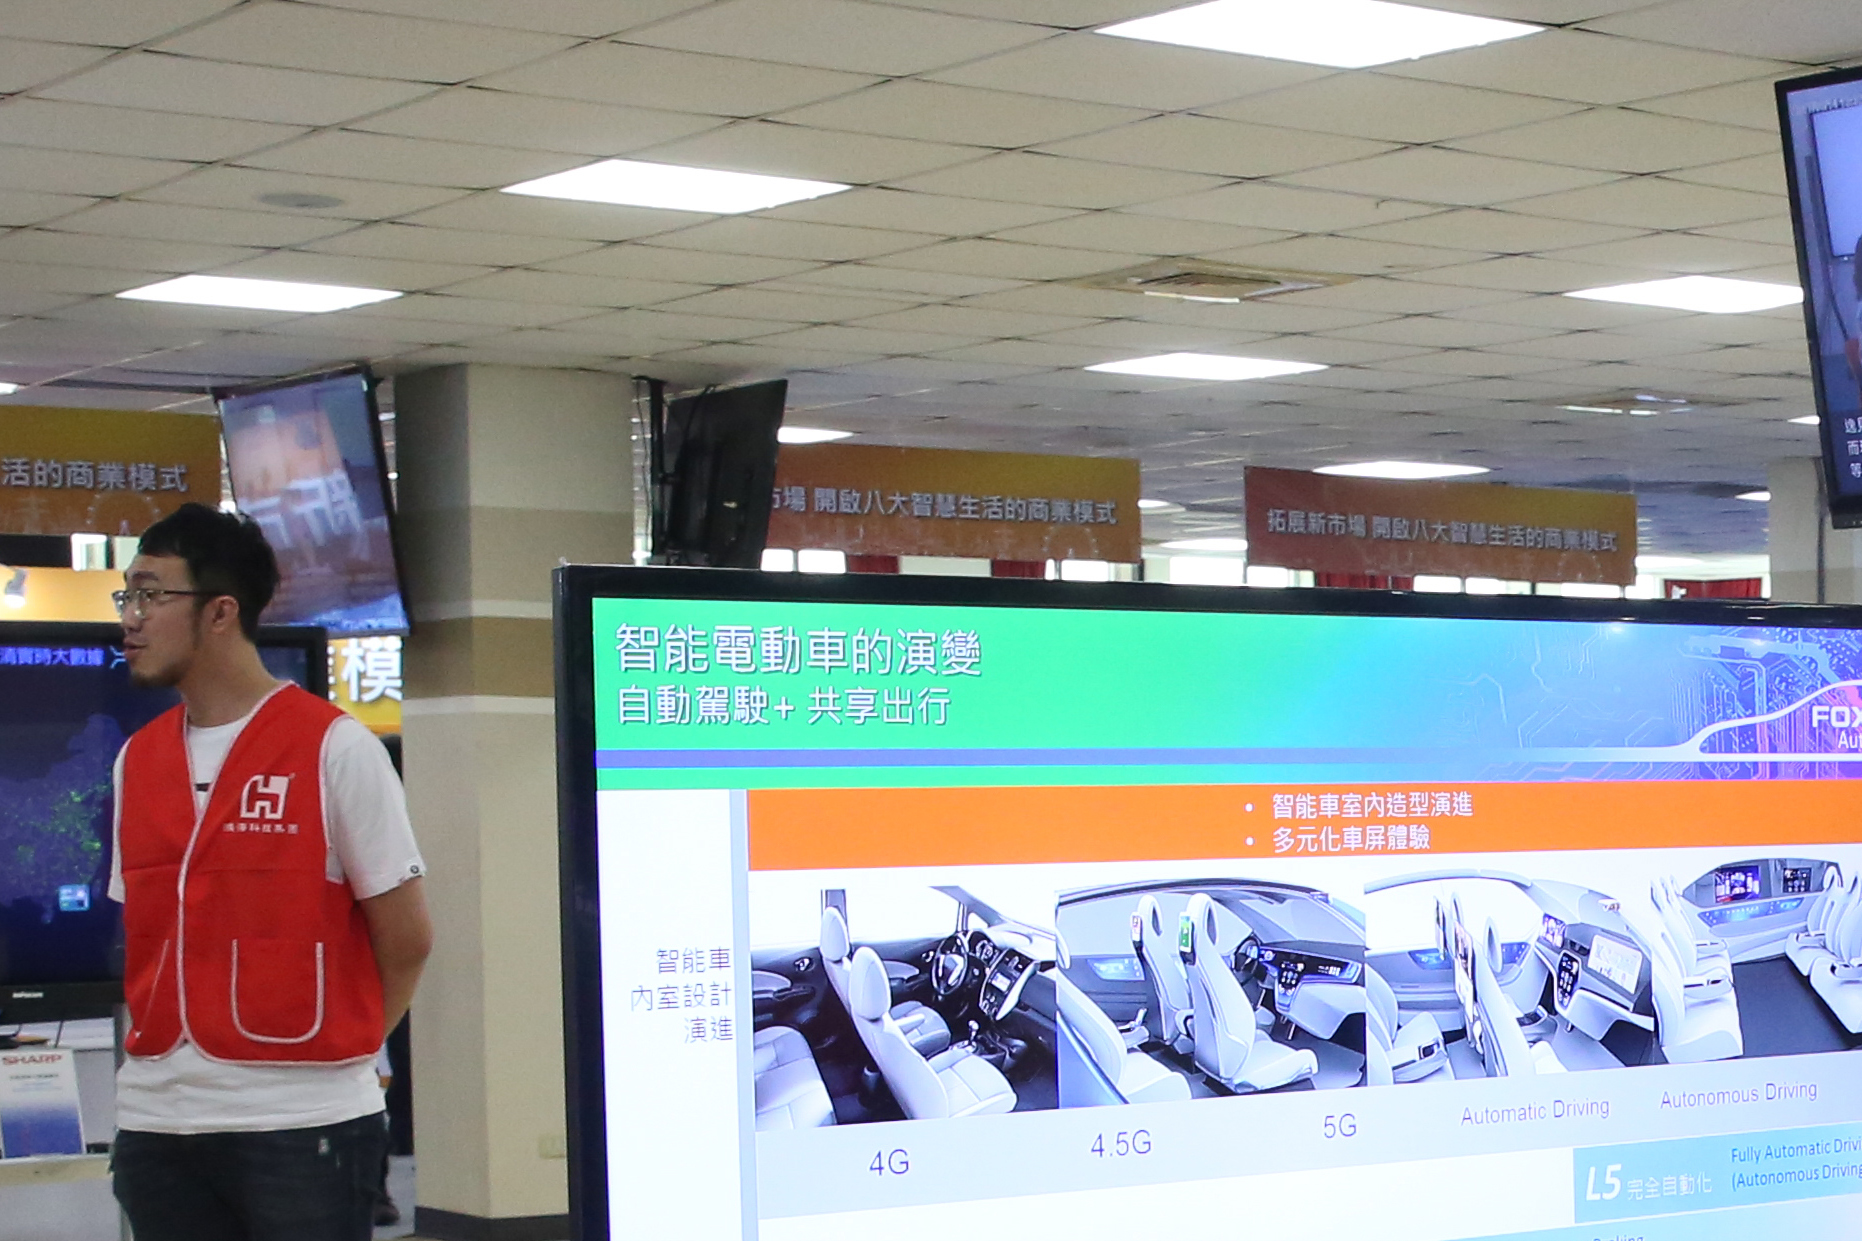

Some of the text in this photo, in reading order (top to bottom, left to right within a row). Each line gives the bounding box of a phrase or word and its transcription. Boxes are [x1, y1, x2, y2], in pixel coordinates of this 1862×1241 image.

[1, 457, 189, 493] 活的商業模式
[1267, 508, 1367, 538] 拓展新市場
[614, 622, 983, 677] 智能電動車的演變
[326, 634, 403, 703] 模
[616, 684, 951, 727] 自動駕駛+ 共享出行
[1272, 791, 1475, 820] 智能車室內造型演進
[1272, 825, 1432, 854] 多元化車屏體驗
[655, 945, 732, 975] 智能車
[630, 979, 734, 1012] 內室設計
[683, 1013, 735, 1044] 演進
[1660, 1078, 1819, 1111] Autonomous Driving
[1322, 1112, 1358, 1140] 5G
[1460, 1094, 1611, 1127] Automatic Driving
[1090, 1129, 1153, 1160] 4.5G
[1731, 1146, 1761, 1164] Fully
[1763, 1138, 1831, 1160] Automatic
[869, 1147, 911, 1177] 4G
[1585, 1163, 1713, 1202] L5 完全自動化
[1731, 1167, 1820, 1192] (Autonomous
